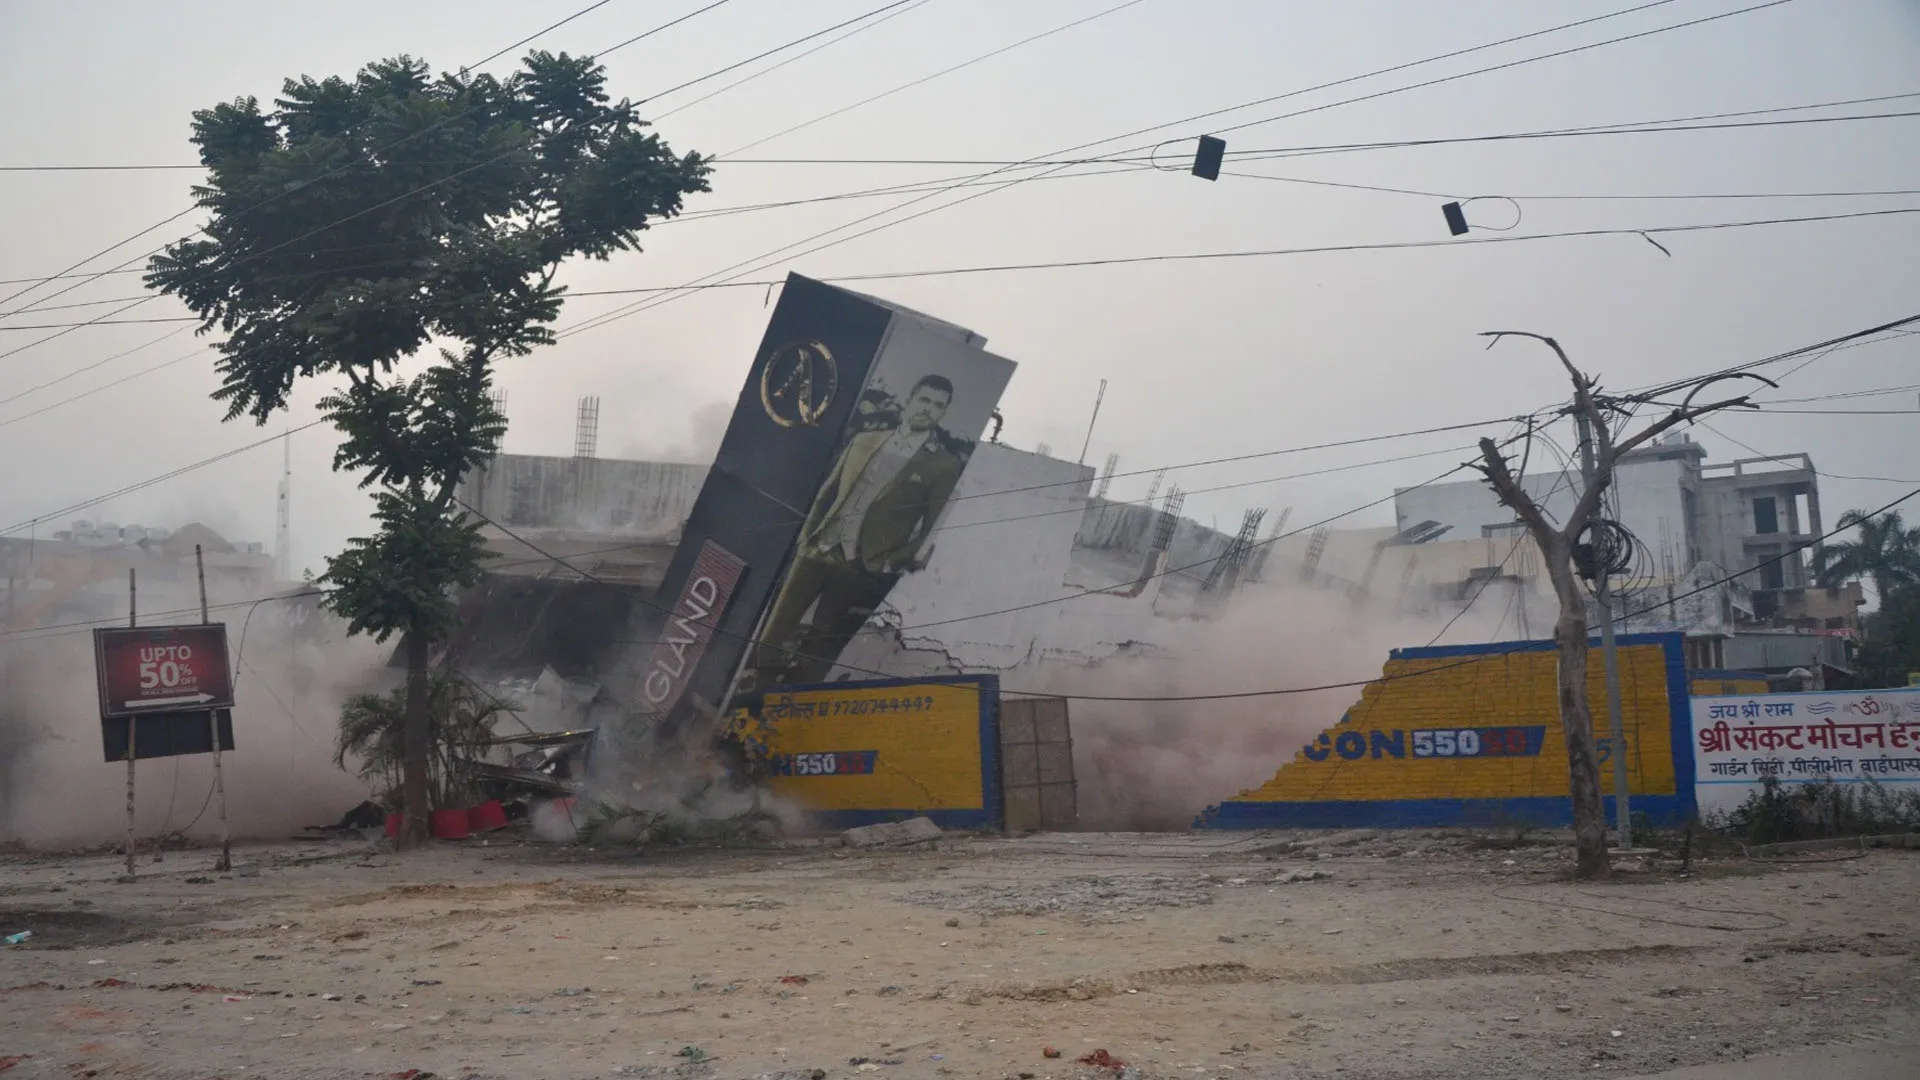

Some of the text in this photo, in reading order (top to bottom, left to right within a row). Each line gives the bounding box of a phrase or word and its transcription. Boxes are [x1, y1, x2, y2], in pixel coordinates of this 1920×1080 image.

[140, 645, 192, 663] UPTO
[180, 676, 197, 686] OFF
[1708, 700, 1795, 719] जय श्री राम
[1699, 720, 1731, 753] श्री
[1733, 722, 1804, 751] संकट
[1807, 717, 1885, 750] मोचन
